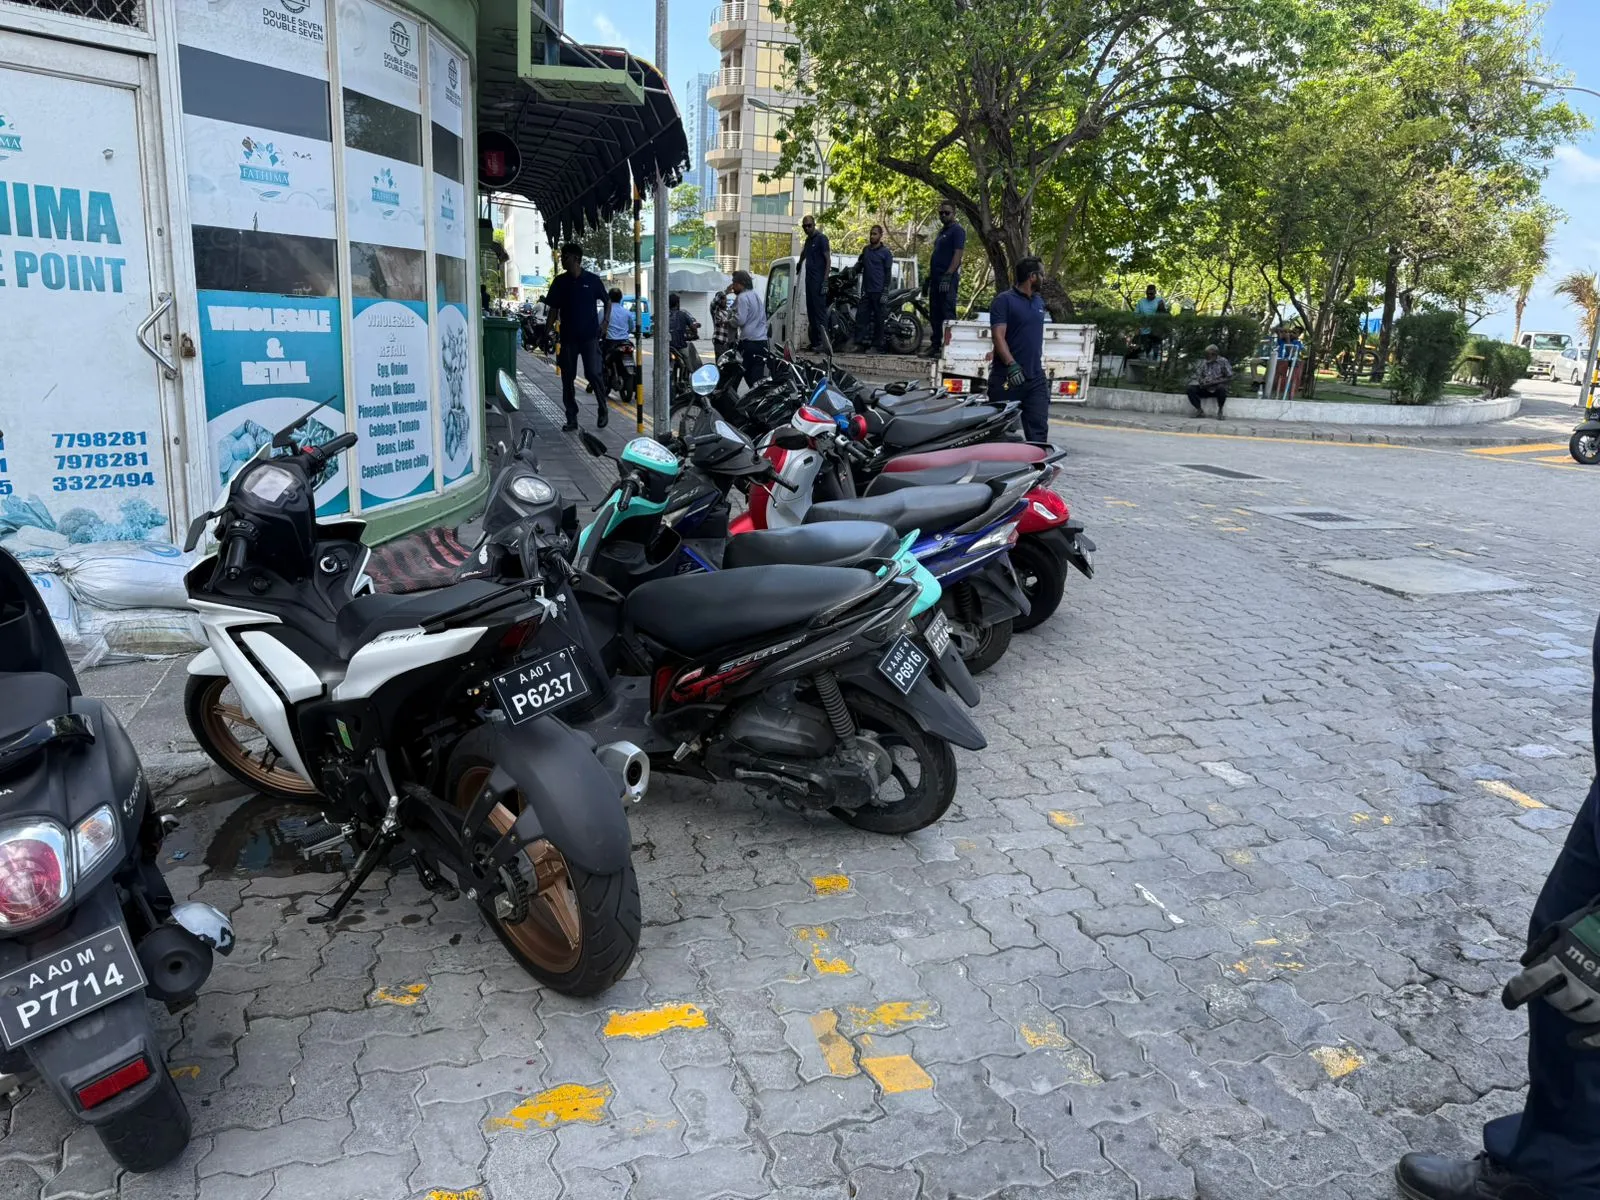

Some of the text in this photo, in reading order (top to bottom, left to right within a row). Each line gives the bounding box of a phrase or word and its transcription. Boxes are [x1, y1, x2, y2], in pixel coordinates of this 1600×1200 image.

[262, 8, 323, 33] DOUBLE SEVEN
[263, 17, 297, 34] DOUBLE
[298, 27, 324, 42] SEVEN
[384, 52, 418, 73] DOUBLE SEVEN
[384, 61, 403, 75] DOUBLE
[403, 69, 418, 80] SEVEN
[243, 168, 288, 184] FATHIMA
[14, 250, 126, 293] POINT
[379, 344, 407, 358] RETAIL
[390, 362, 408, 376] Onion
[392, 400, 428, 415] Watermelon
[398, 419, 420, 433] Tomato
[51, 431, 147, 449] 7798281
[398, 438, 415, 453] Leeks
[54, 452, 149, 470] 7978281
[394, 458, 412, 472] Green
[413, 454, 429, 469] chilly
[52, 471, 155, 492] 3322494
[519, 673, 529, 684] A
[543, 661, 552, 672] T
[894, 650, 922, 686] P6916
[511, 672, 573, 715] P6237
[28, 973, 45, 989] A
[76, 948, 96, 967] M
[16, 962, 125, 1029] P7714
